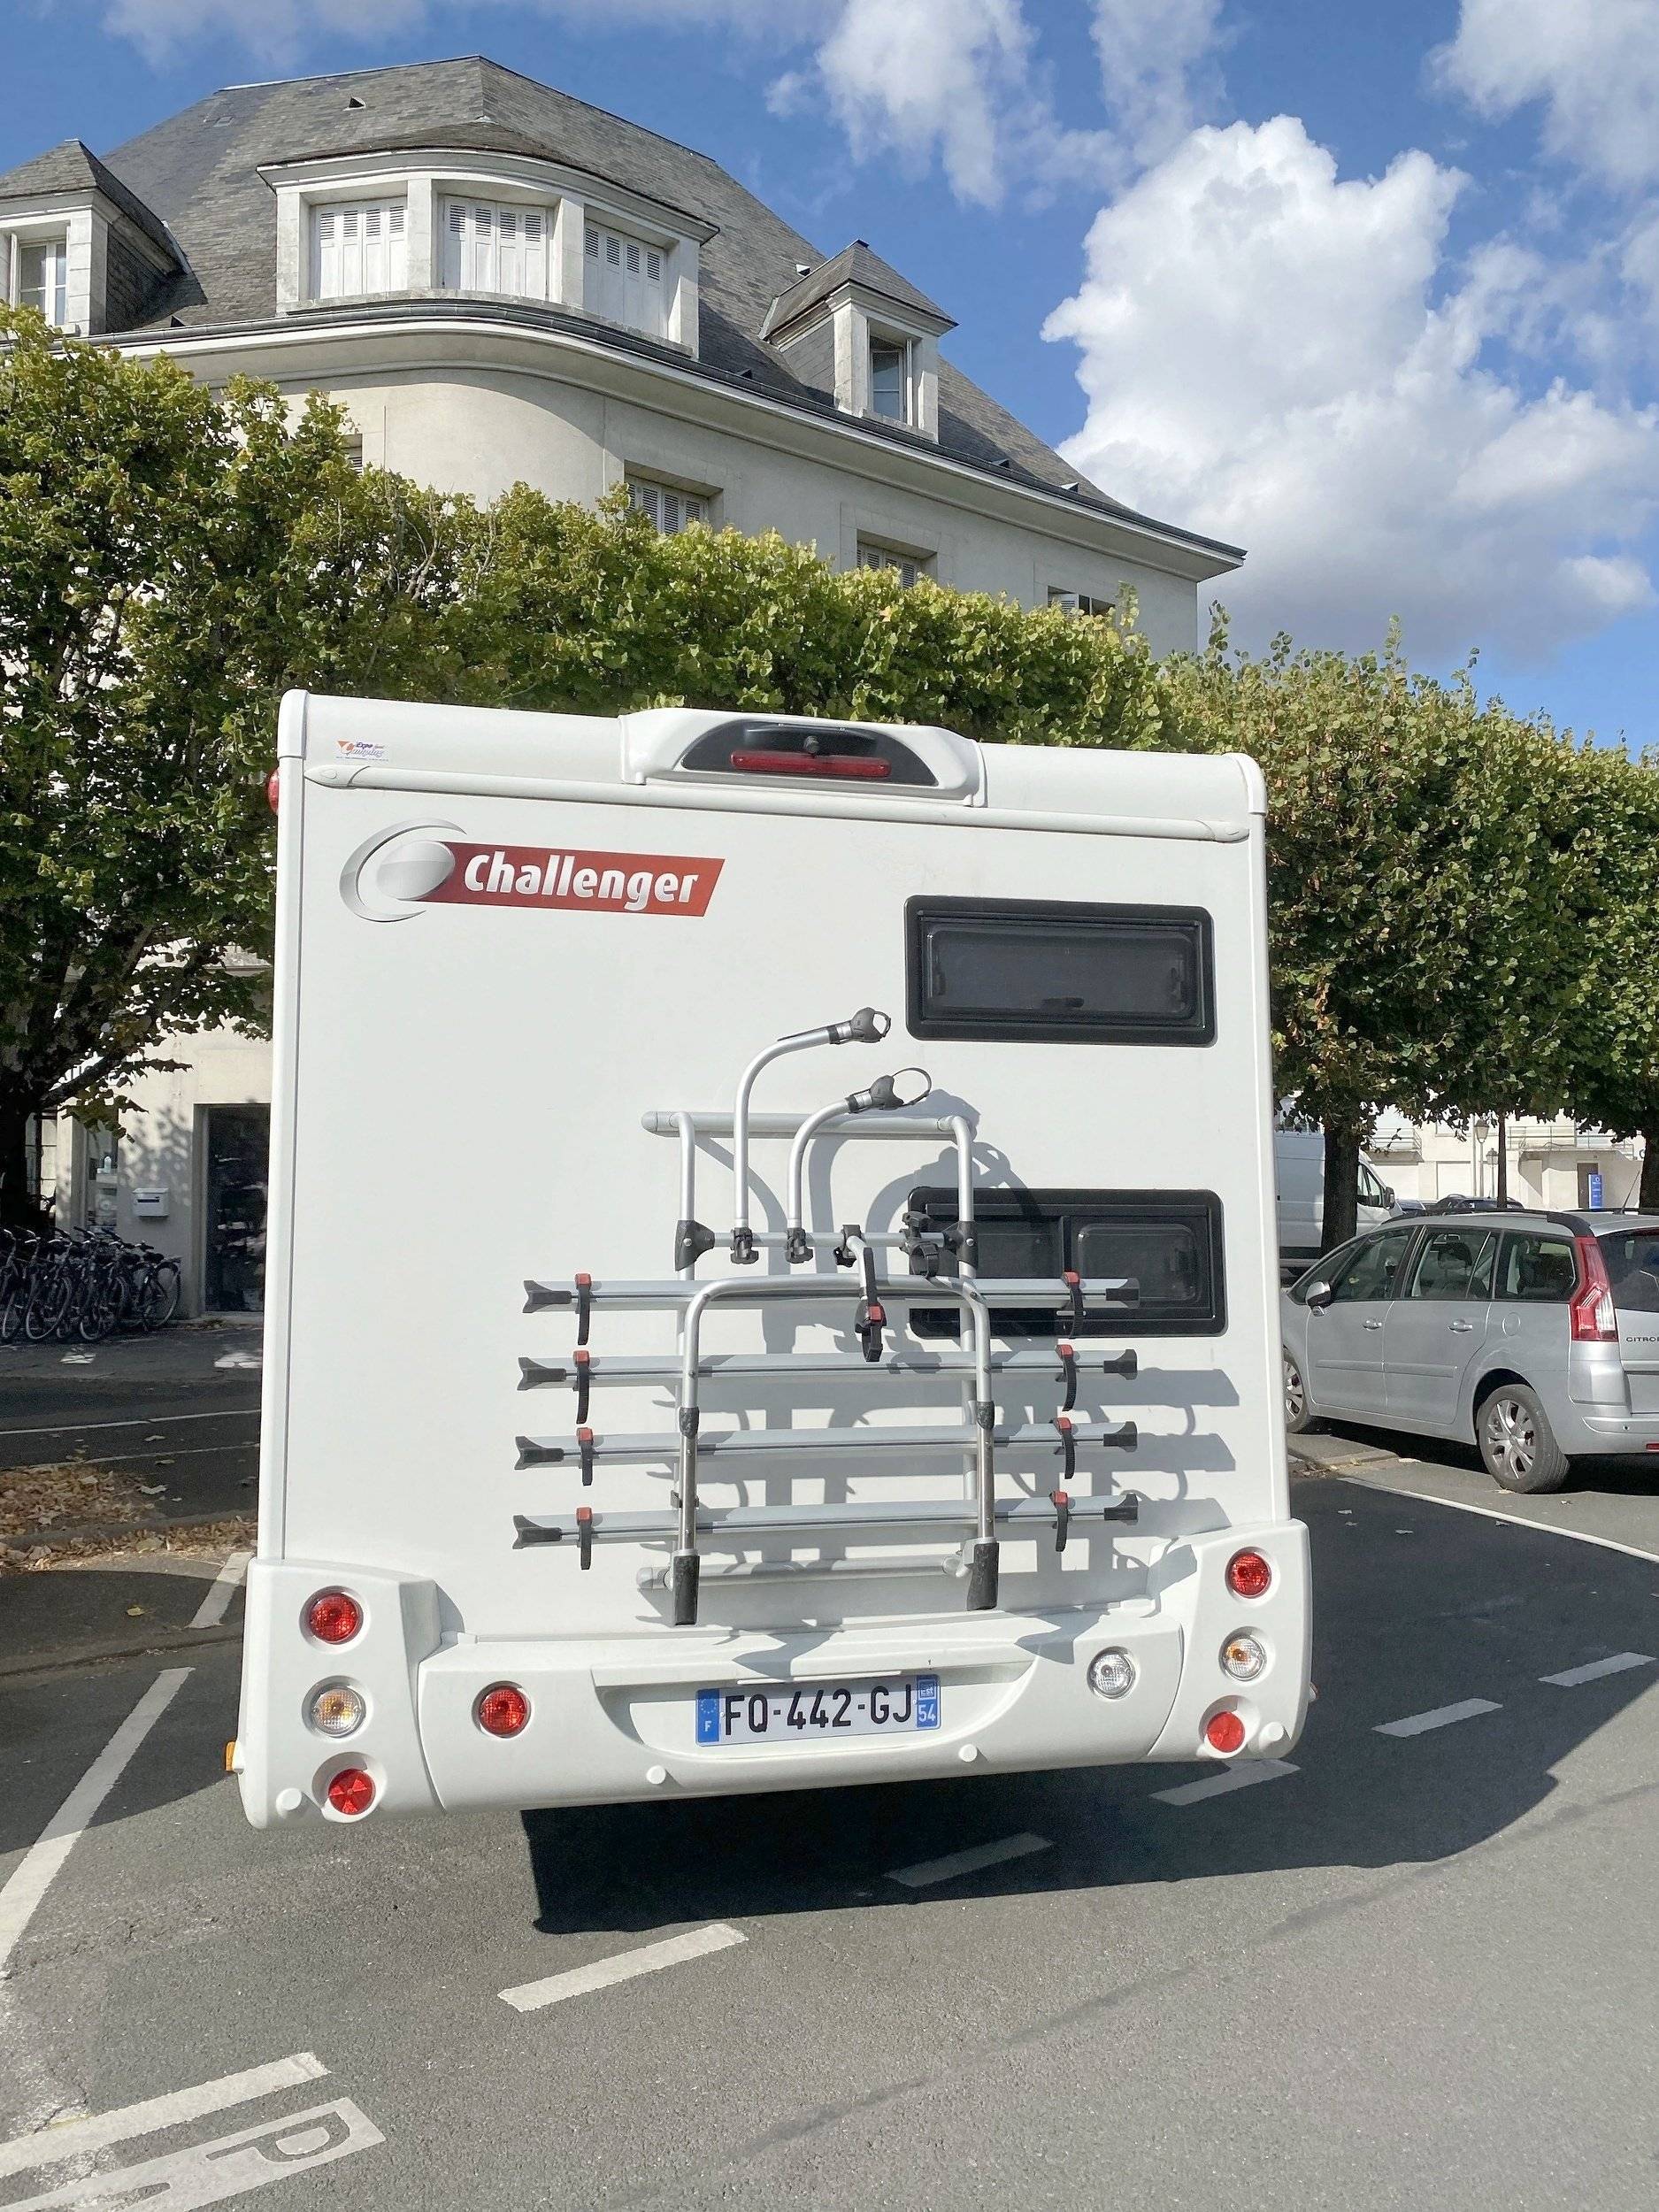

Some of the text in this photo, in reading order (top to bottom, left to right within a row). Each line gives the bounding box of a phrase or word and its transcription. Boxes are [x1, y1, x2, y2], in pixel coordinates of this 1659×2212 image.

[464, 850, 699, 911] Challenger
[704, 1720, 712, 1732] F
[725, 1684, 911, 1735] FQ-442-GJ
[918, 1703, 936, 1723] 54
